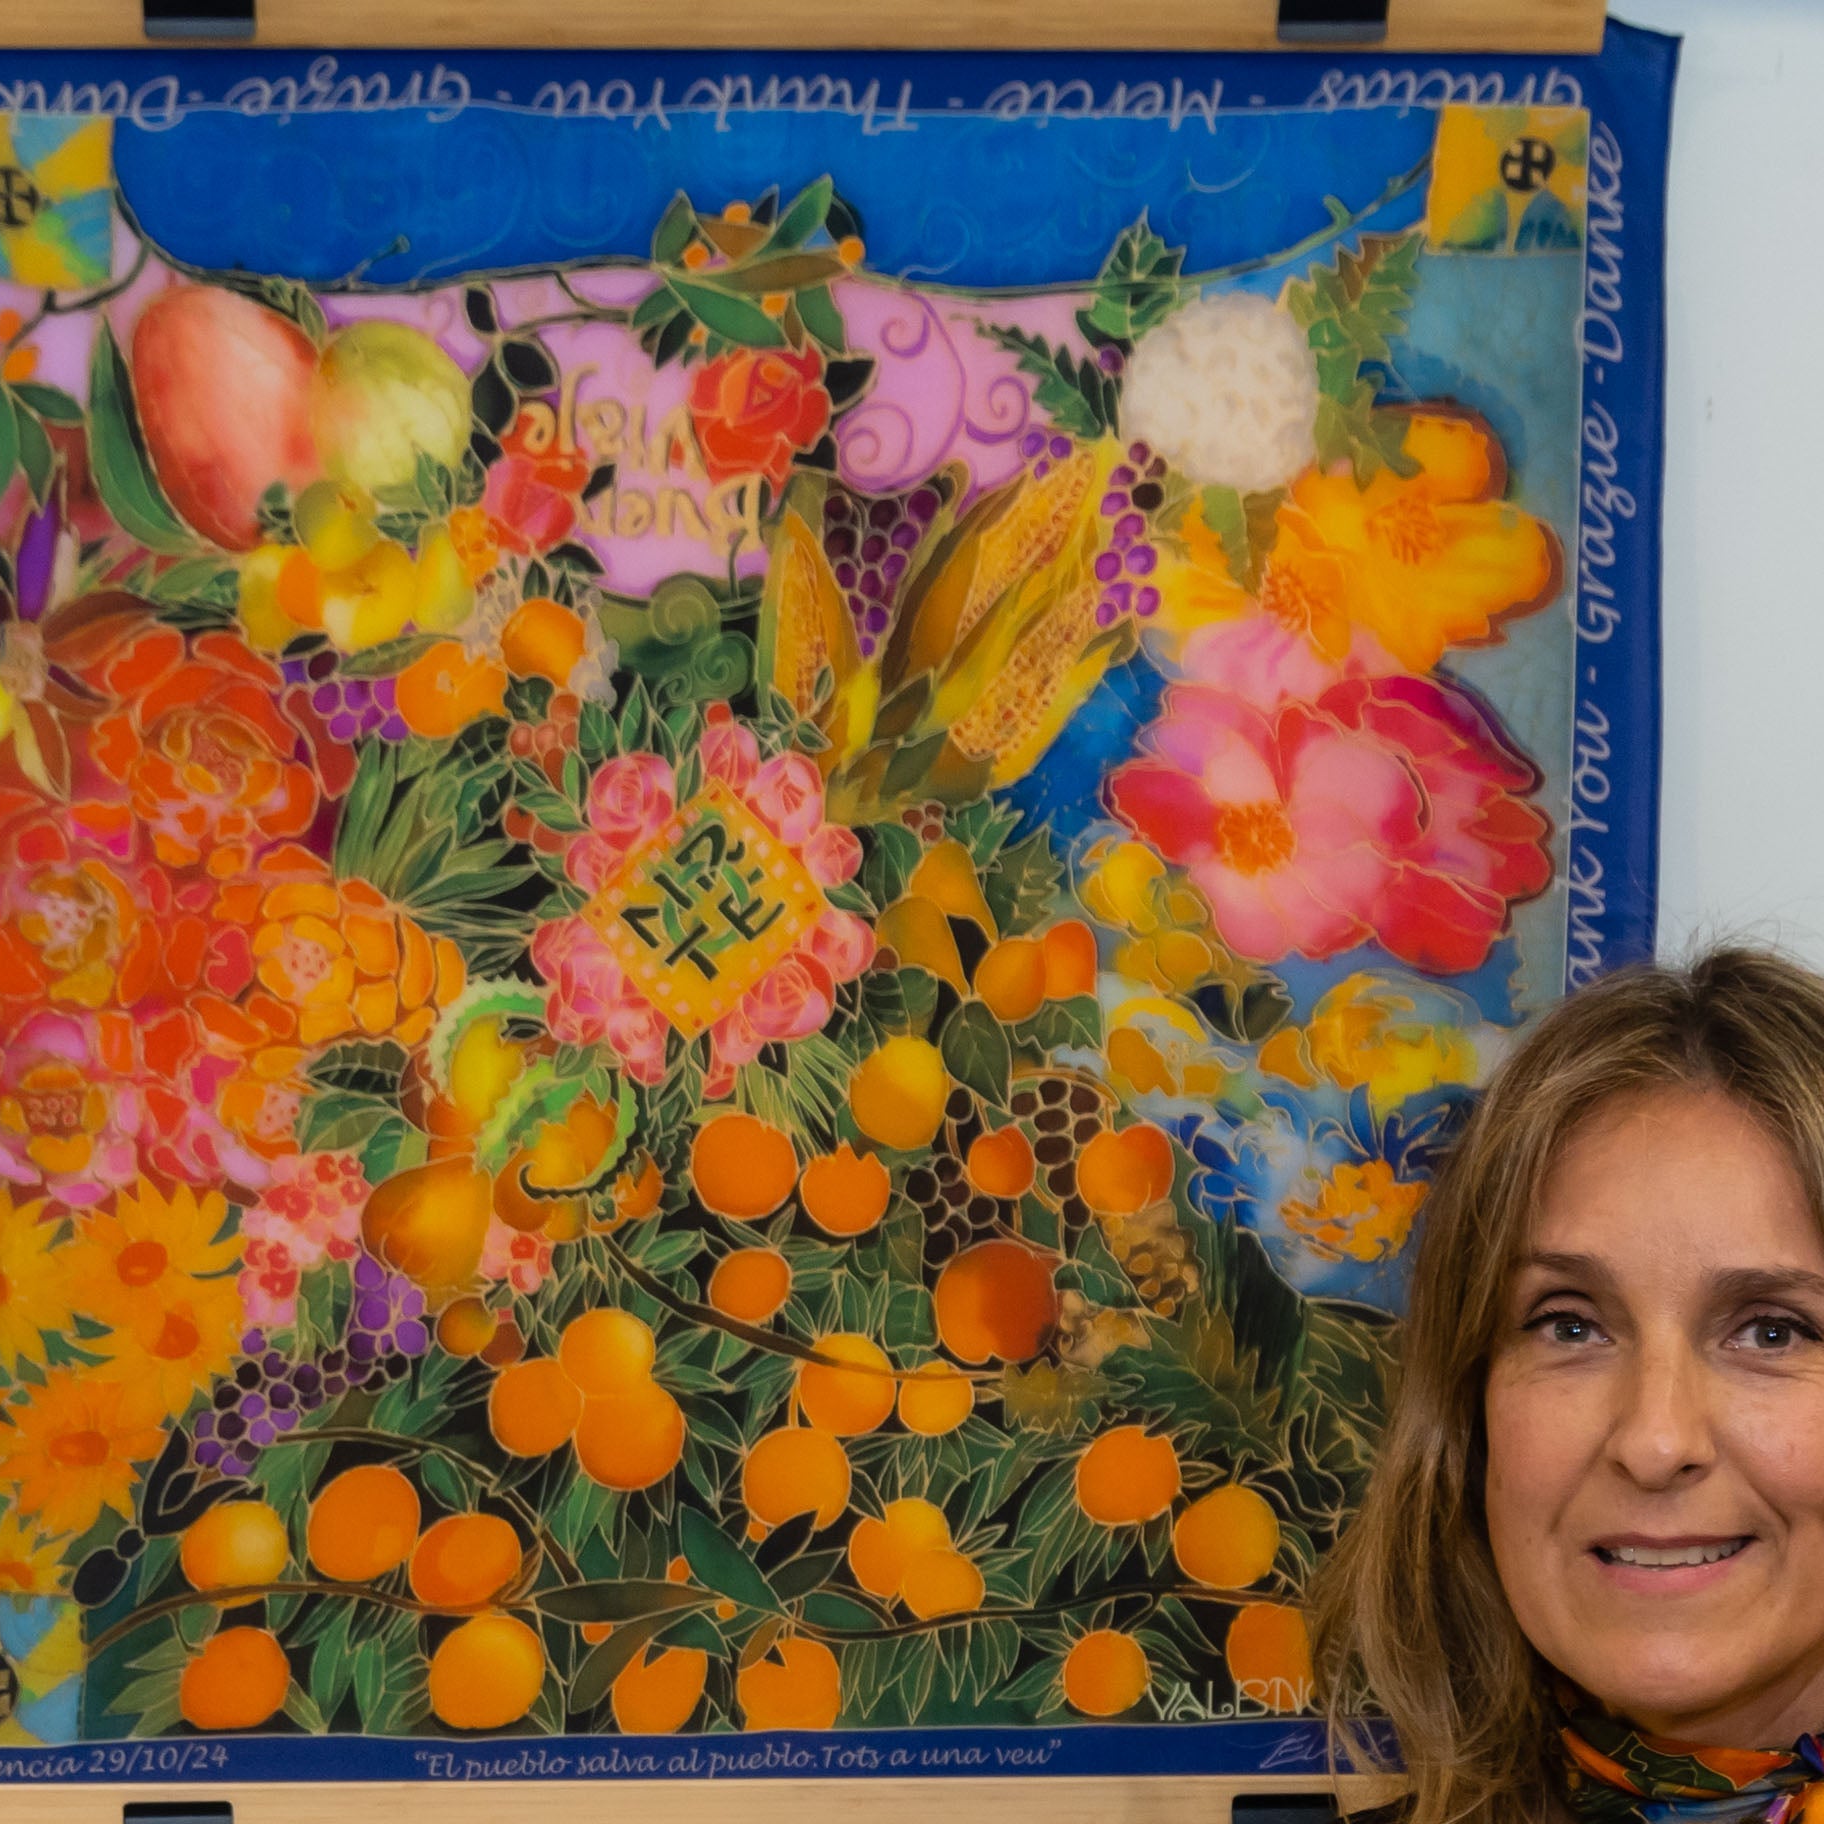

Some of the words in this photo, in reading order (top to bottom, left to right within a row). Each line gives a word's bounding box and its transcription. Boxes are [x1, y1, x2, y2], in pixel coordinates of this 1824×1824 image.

[1568, 401, 1636, 643] Grazie
[1558, 699, 1611, 833] You
[1553, 846, 1606, 987] ank
[87, 1742, 230, 1776] 29/10/24
[464, 1750, 570, 1781] pueblo
[576, 1747, 662, 1775] salva
[668, 1746, 704, 1775] al
[888, 1749, 910, 1768] a
[913, 1748, 989, 1768] una
